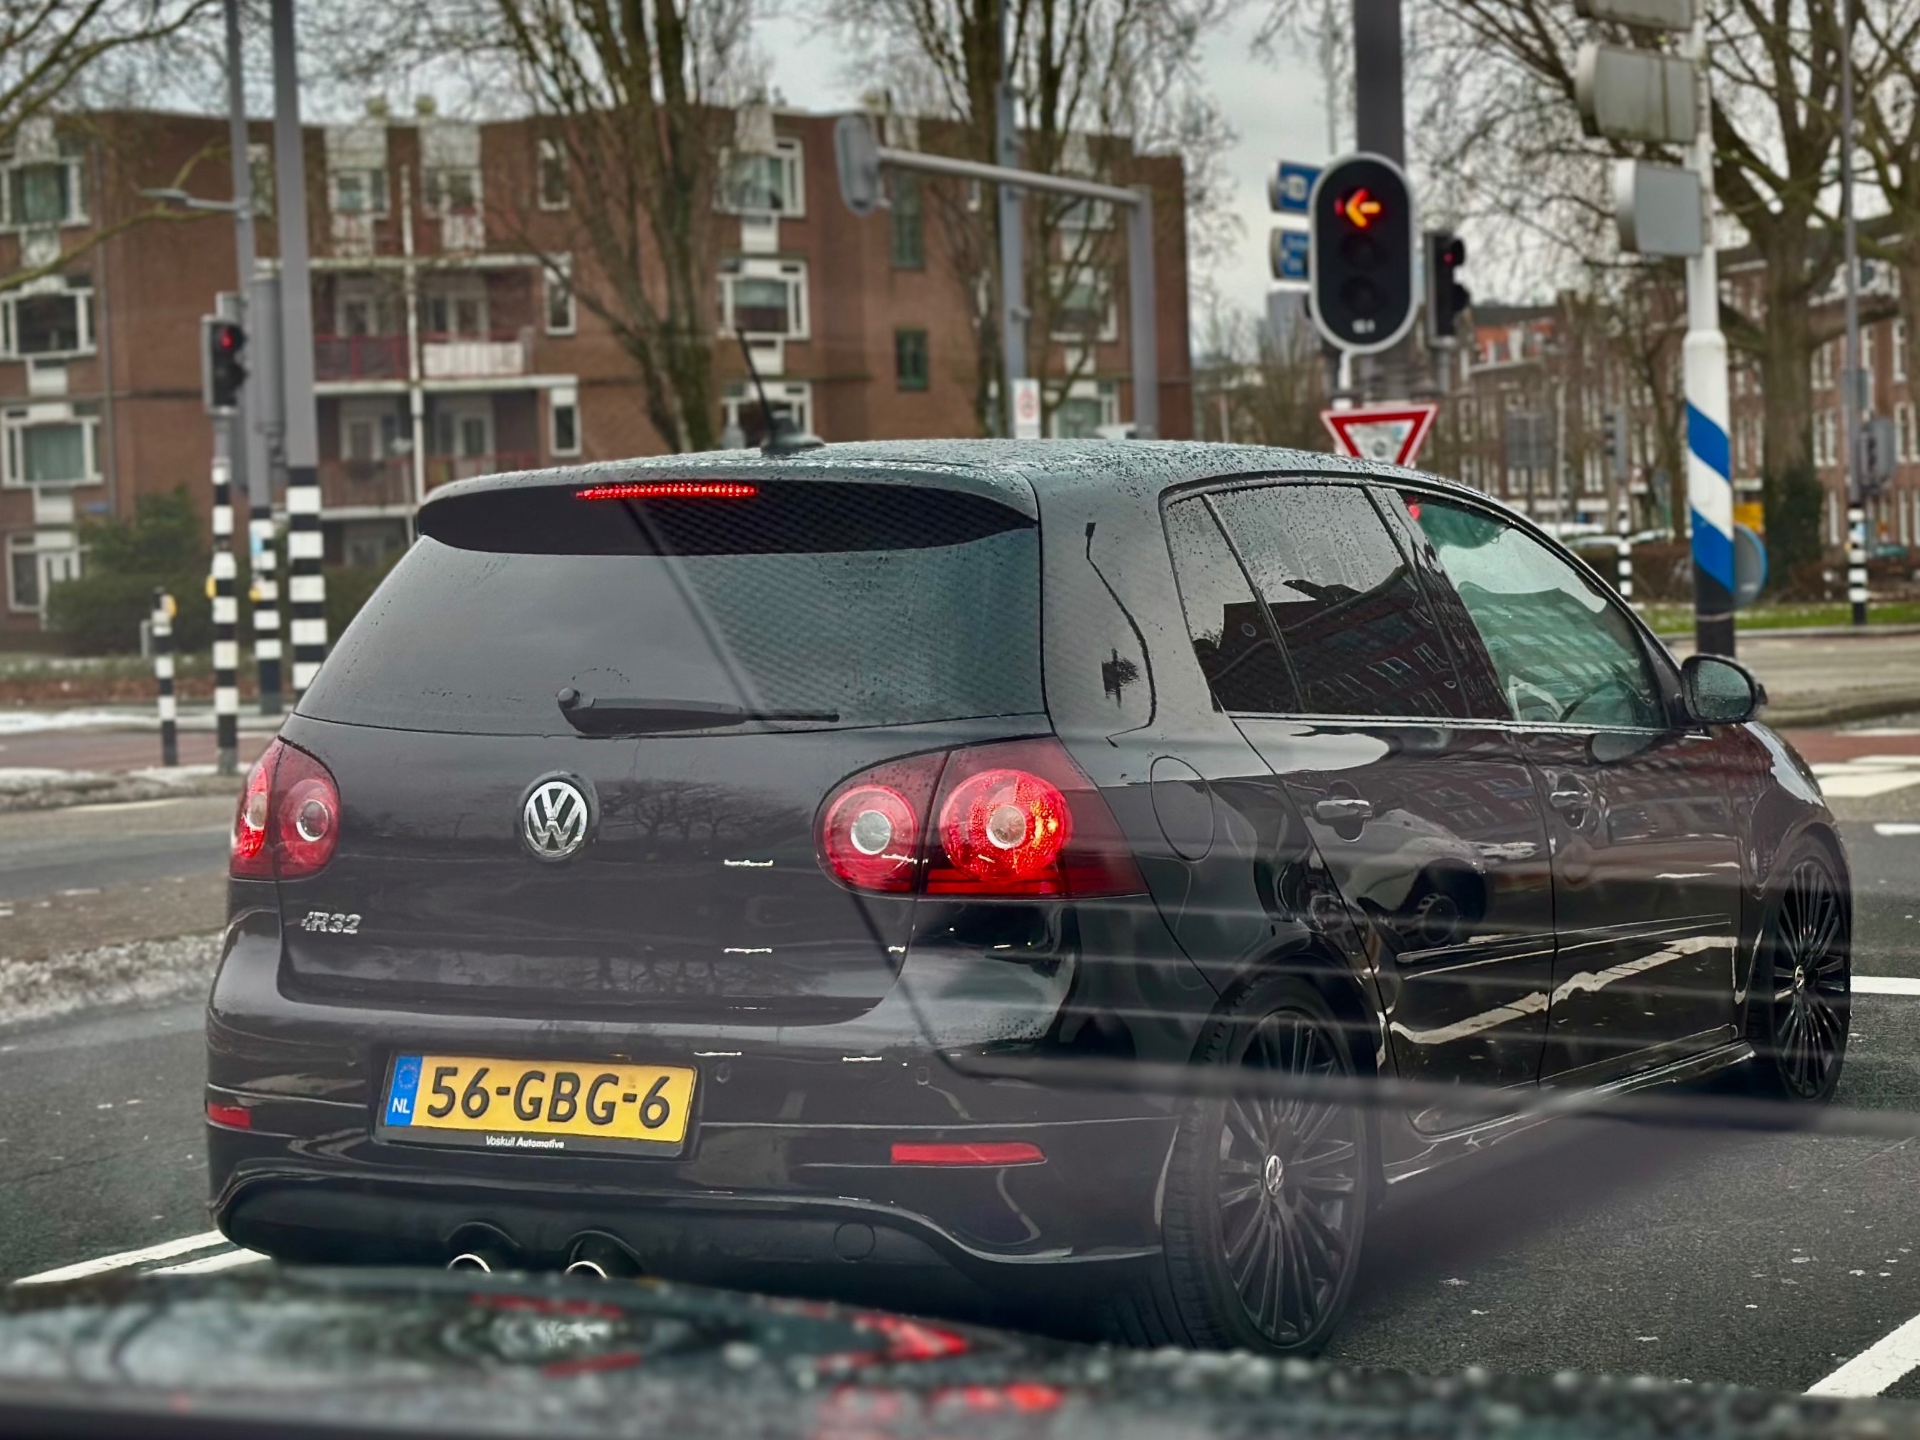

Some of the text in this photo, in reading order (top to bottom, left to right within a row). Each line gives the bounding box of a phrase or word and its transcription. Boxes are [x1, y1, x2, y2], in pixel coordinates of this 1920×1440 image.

[525, 782, 587, 856] VW
[303, 911, 361, 934] R32
[391, 1097, 411, 1115] NL
[427, 1066, 671, 1129] 56-GBG-6
[486, 1134, 565, 1149] Voskuil Automotive
